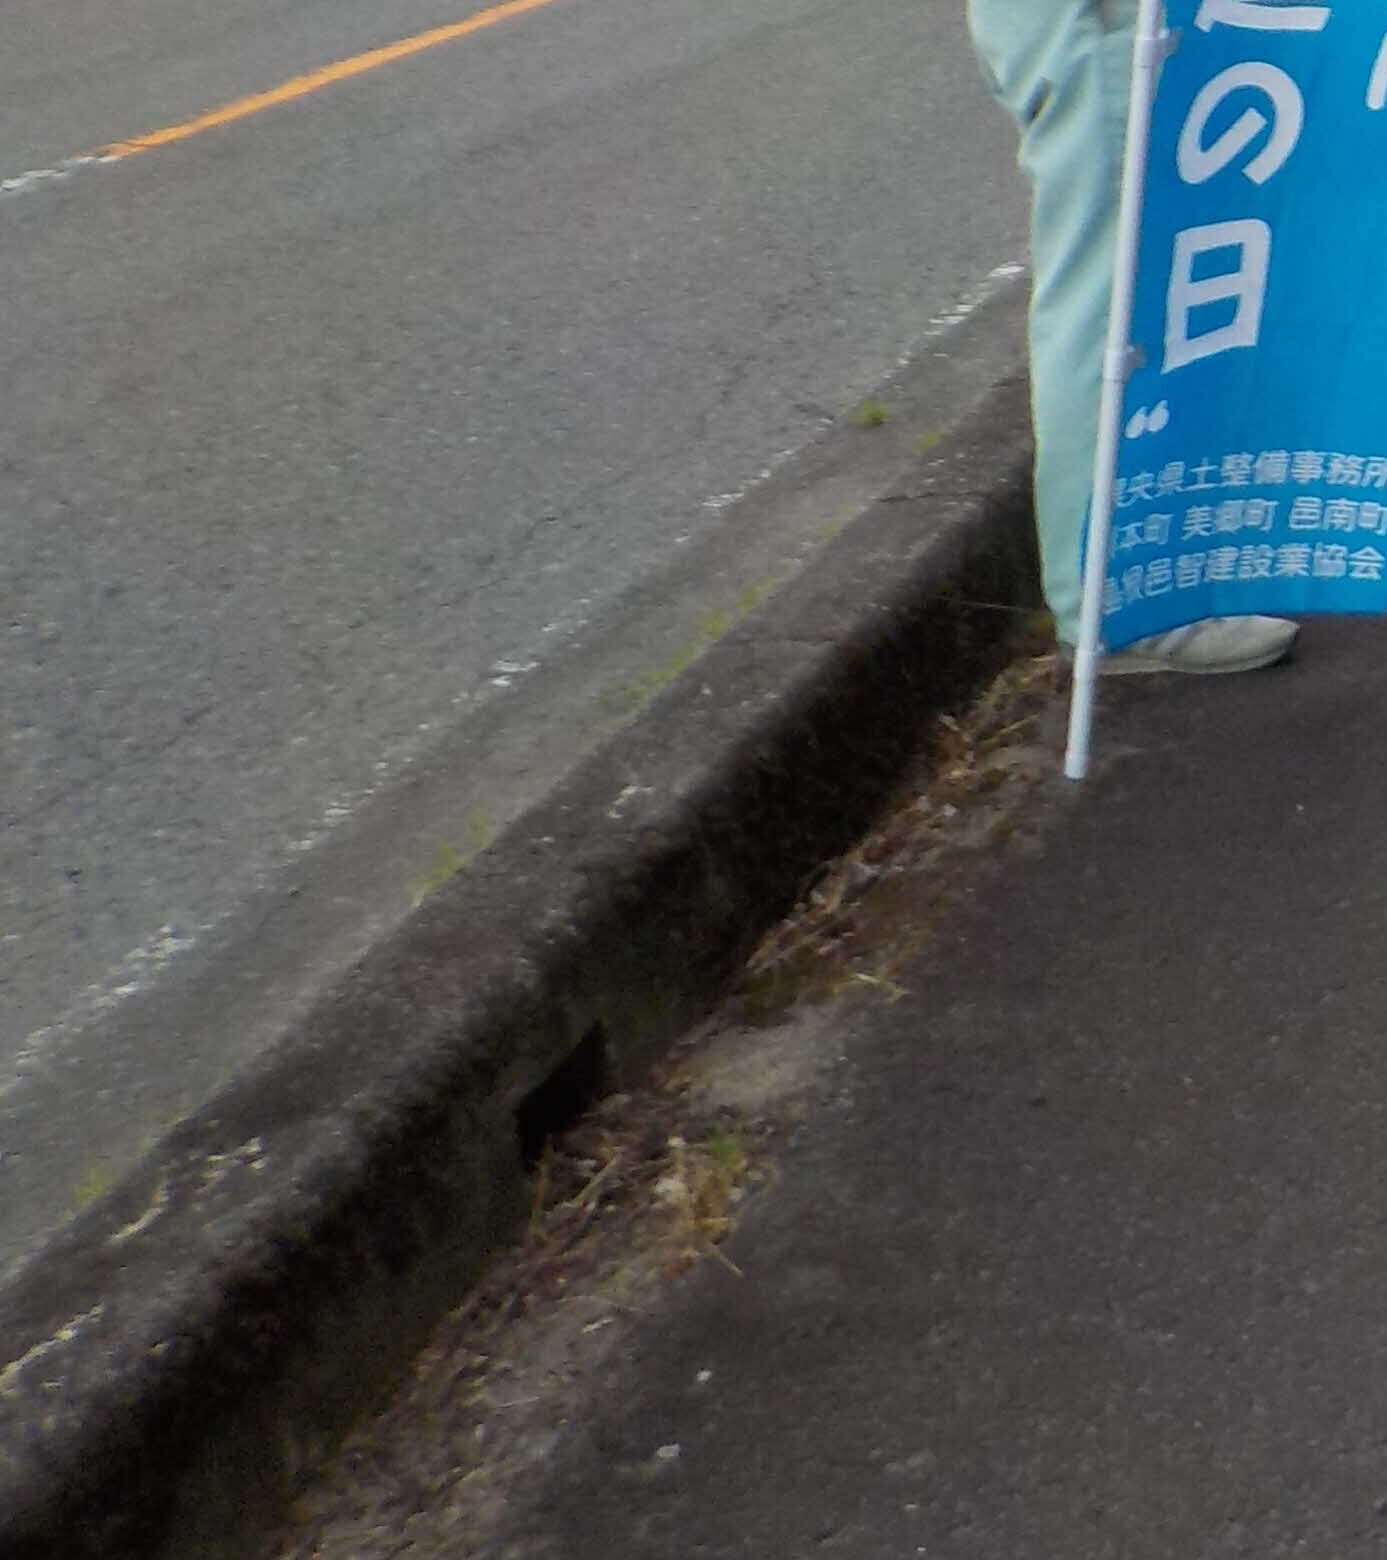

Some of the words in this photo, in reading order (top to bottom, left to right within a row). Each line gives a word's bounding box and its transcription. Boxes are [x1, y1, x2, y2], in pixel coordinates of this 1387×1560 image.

[1112, 513, 1174, 557] 本町
[1181, 498, 1280, 542] 美郷町
